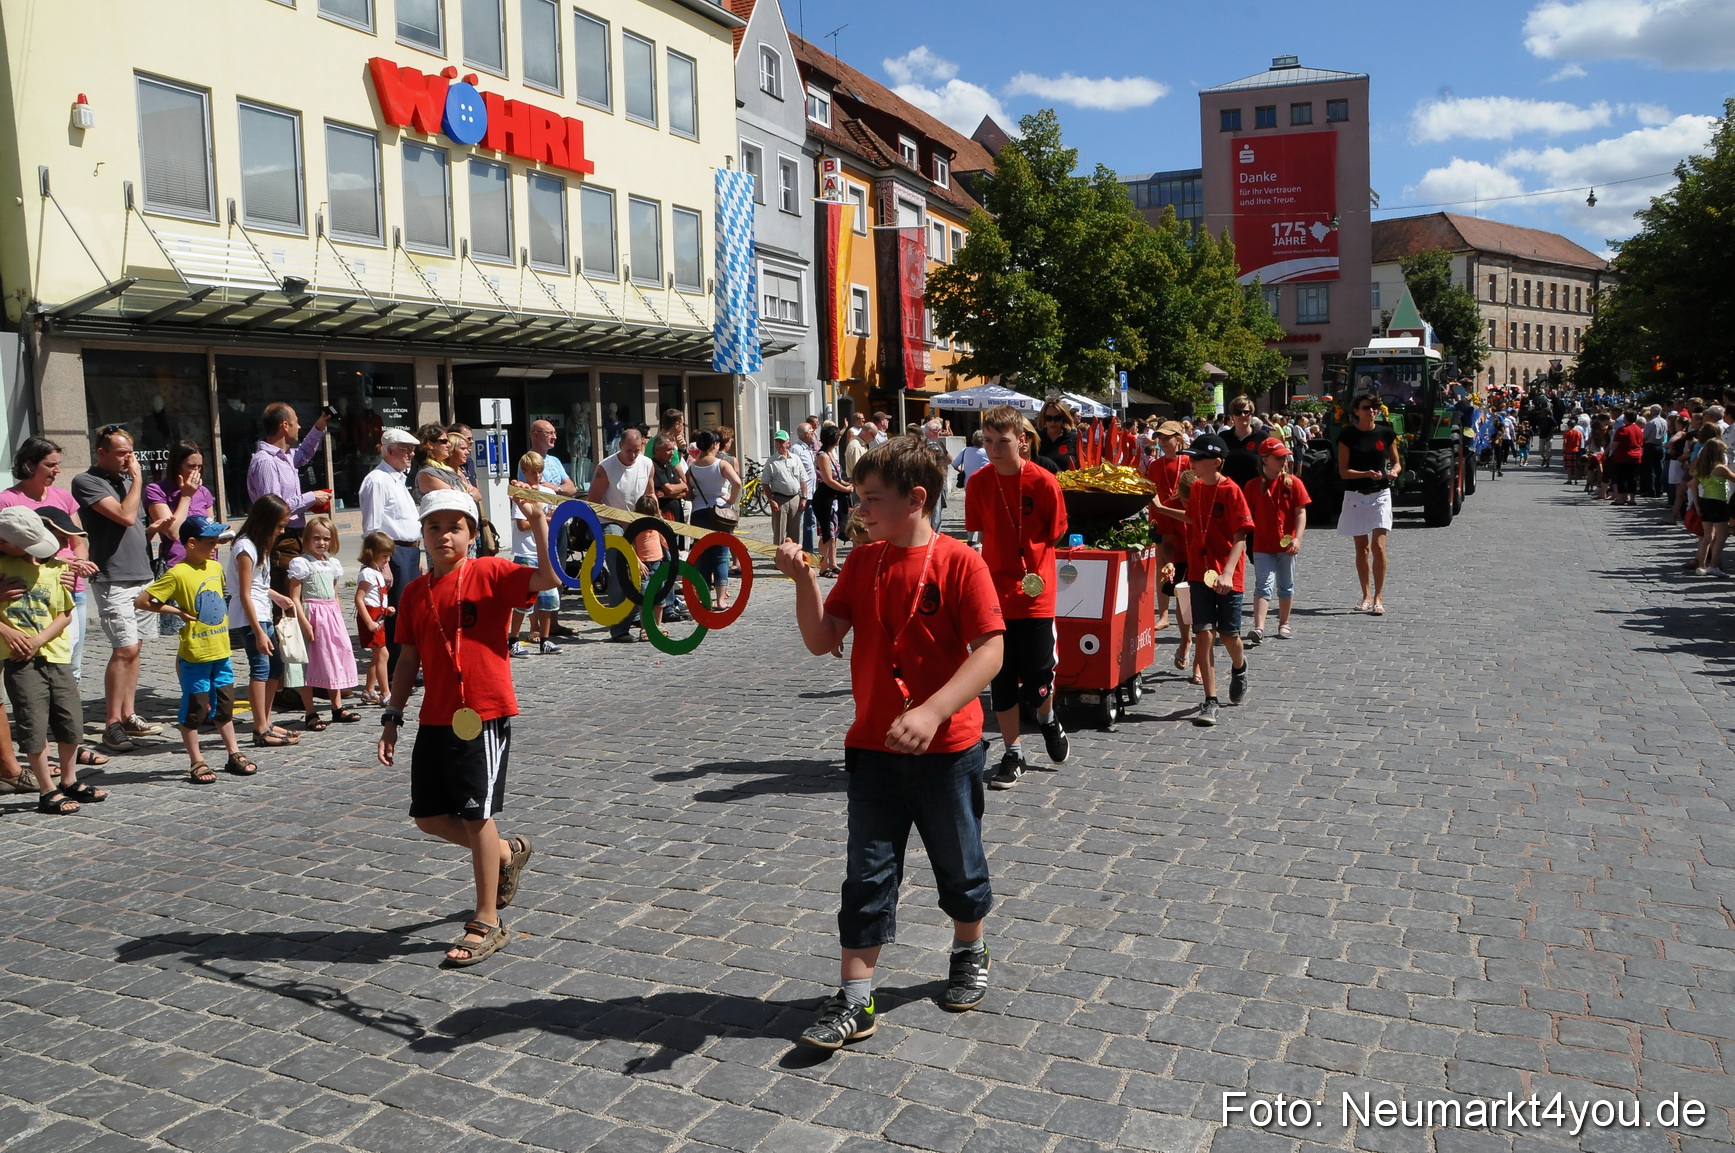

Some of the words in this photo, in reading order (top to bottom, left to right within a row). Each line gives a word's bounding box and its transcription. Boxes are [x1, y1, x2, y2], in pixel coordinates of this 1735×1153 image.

[368, 57, 594, 174] WÖHRL
[1240, 171, 1277, 183] Danke
[1252, 187, 1263, 195] Ihr
[1264, 186, 1302, 194] Vertrauen
[1240, 198, 1255, 206] und
[1256, 197, 1271, 205] Ihre
[1271, 221, 1307, 237] 175
[1272, 236, 1307, 246] JAHRE
